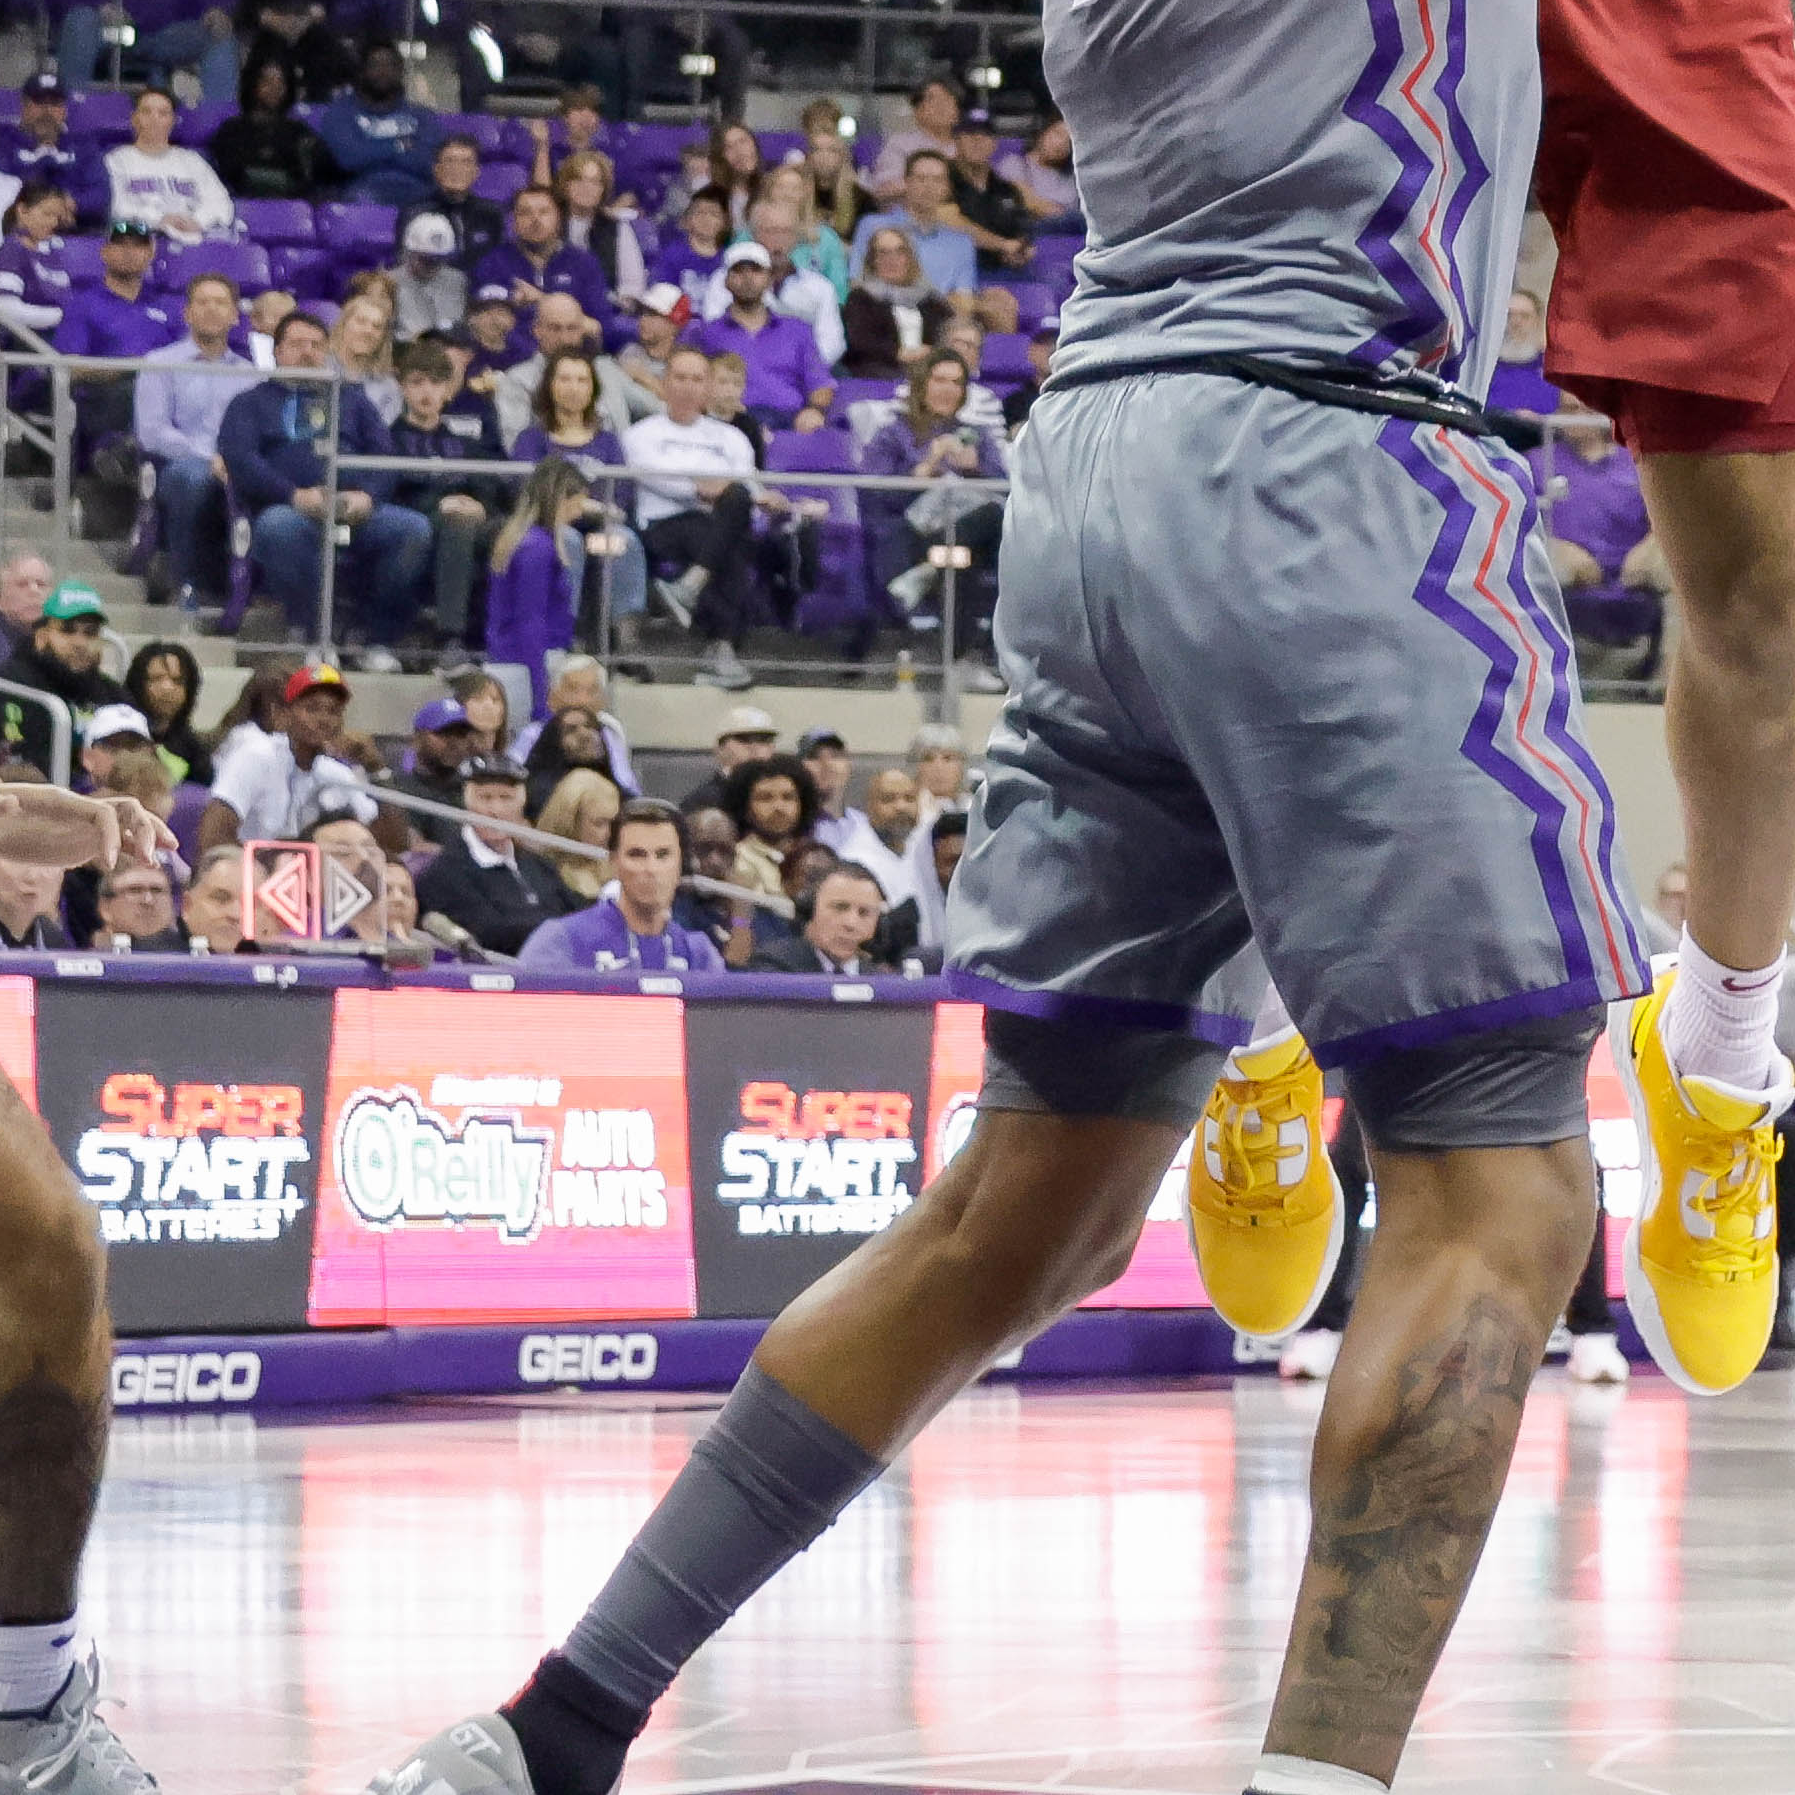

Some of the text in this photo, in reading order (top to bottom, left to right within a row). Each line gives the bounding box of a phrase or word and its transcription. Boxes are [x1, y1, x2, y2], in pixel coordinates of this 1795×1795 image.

[100, 1073, 304, 1137] SUPER
[740, 1080, 913, 1140] SUPER
[76, 1129, 311, 1202] START
[342, 1096, 547, 1238] O'Reilly
[717, 1132, 918, 1199] START
[99, 1207, 282, 1242] BATTERIES
[112, 1352, 262, 1405] GEICO
[519, 1334, 658, 1382] GEICO
